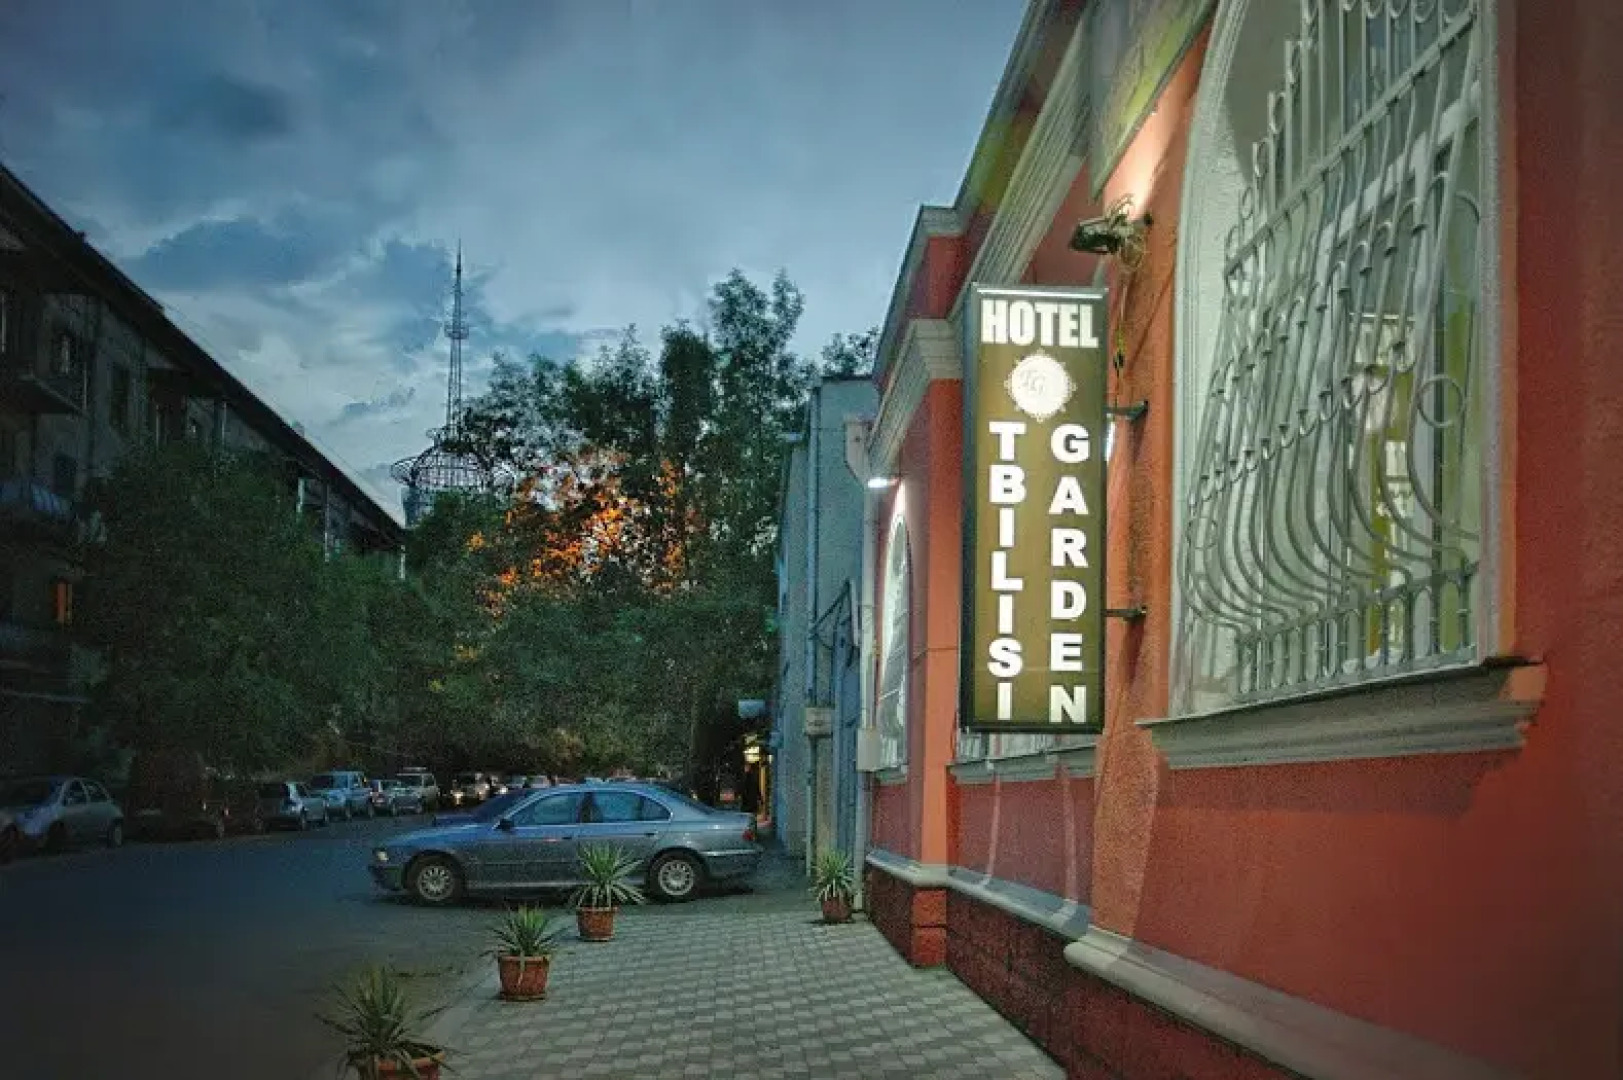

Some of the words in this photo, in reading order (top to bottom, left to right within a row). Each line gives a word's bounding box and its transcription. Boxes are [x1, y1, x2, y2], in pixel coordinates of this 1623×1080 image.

[981, 300, 1099, 348] HOTEL
[987, 421, 1027, 720] TBILISI
[1049, 423, 1090, 723] GARDEN
